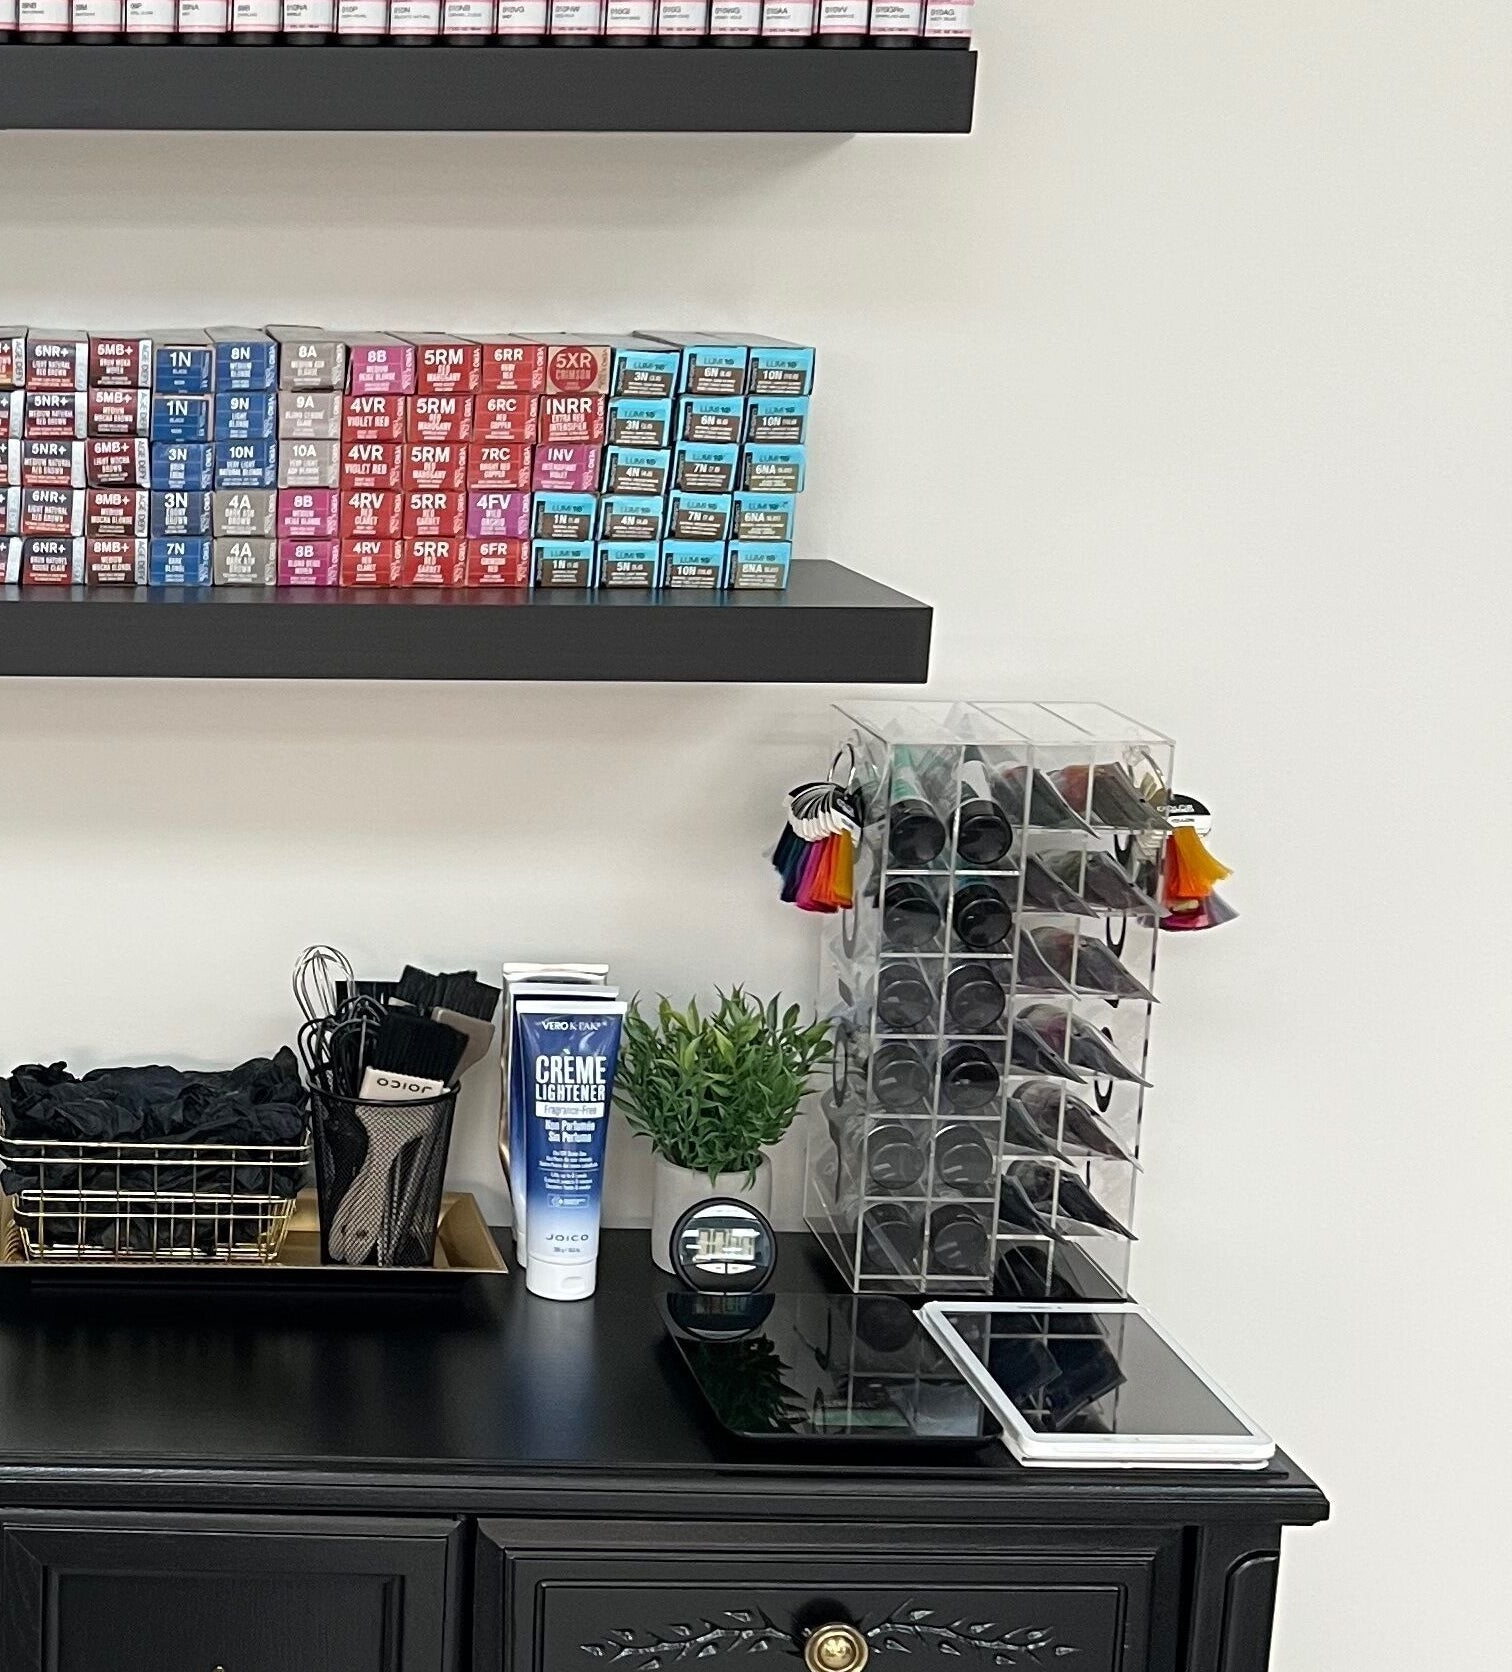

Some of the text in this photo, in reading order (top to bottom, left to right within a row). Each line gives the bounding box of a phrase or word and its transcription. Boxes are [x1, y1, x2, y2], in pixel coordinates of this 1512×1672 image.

[35, 347, 69, 358] 6NR+
[231, 348, 251, 360] 8N
[299, 346, 317, 358] 8A
[368, 351, 387, 362] 8B
[425, 349, 463, 365] 5RM
[494, 349, 523, 361] 6RR
[170, 353, 191, 366] 1N
[556, 353, 591, 368] 5XR
[167, 401, 188, 415] 1N
[230, 398, 250, 410] 9N
[296, 397, 314, 409] 9A
[350, 398, 385, 413] 4VR
[417, 398, 455, 414] 5RM
[488, 400, 517, 411] 6RC
[547, 399, 591, 414] INRR
[32, 444, 67, 455] 5NR+
[94, 443, 130, 453] 6MB+
[229, 447, 254, 458] 10N
[293, 445, 316, 457] 10A
[348, 445, 383, 460] 4VR
[168, 450, 187, 461] 3N
[412, 447, 450, 462] 5RM
[482, 449, 510, 460] 7RC
[548, 449, 573, 460] INV
[32, 492, 67, 503] 6NR+
[165, 493, 188, 507] 3N
[229, 495, 251, 509] 4A
[294, 496, 313, 508] 8B
[349, 493, 384, 509] 4RV
[411, 493, 447, 509] 5RR
[477, 494, 511, 509] 4FV
[32, 543, 66, 554] 6NR+
[167, 543, 185, 555] 7N
[230, 543, 252, 556] 4A
[295, 546, 314, 558] 8B
[353, 542, 380, 554] 4RV
[414, 542, 449, 557] 5RR
[480, 543, 508, 555] 6FR
[541, 1021, 568, 1030] VERO
[535, 1048, 607, 1084] CRÈME
[377, 1078, 432, 1093] JOICO
[535, 1084, 606, 1101] LIGHTENER
[546, 1234, 589, 1242] JOICO
